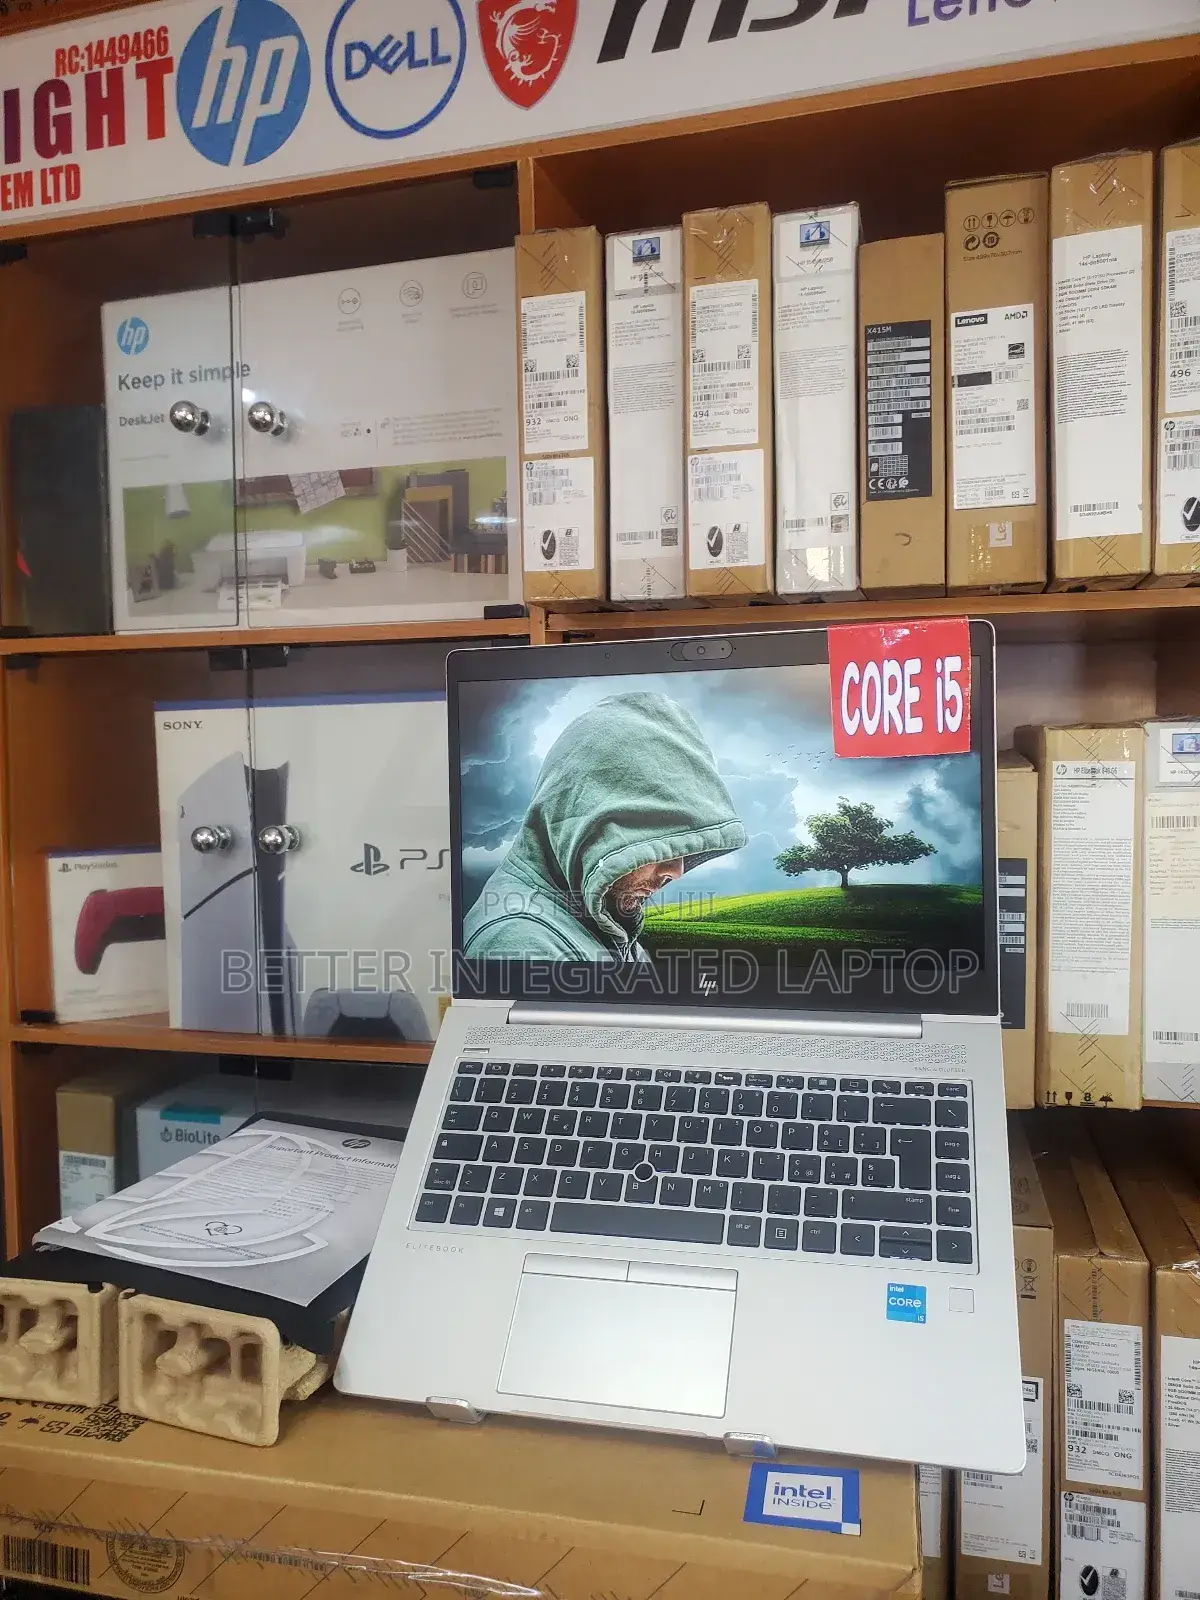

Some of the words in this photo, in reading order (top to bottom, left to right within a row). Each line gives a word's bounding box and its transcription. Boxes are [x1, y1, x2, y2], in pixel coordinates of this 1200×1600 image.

[55, 25, 169, 78] RC:1449466
[345, 27, 452, 81] DELL
[40, 163, 81, 206] LTD
[956, 315, 985, 325] Lenovo
[1004, 311, 1022, 321] AMD
[121, 316, 147, 355] hp
[867, 325, 892, 334] X415M
[118, 373, 165, 391] Keep
[171, 368, 183, 384] it
[189, 361, 251, 383] simple
[1170, 368, 1191, 378] 496
[119, 413, 165, 427] DeskJet
[525, 418, 542, 426] 932
[563, 414, 579, 422] ONG
[692, 409, 710, 419] 494
[841, 657, 924, 737] CORE
[935, 655, 965, 735] i5
[163, 719, 203, 731] SONY
[491, 1111, 498, 1119] Q
[522, 1112, 533, 1120] W
[685, 1121, 692, 1129] U
[754, 1126, 762, 1134] O
[175, 1129, 220, 1145] BioLite
[267, 1144, 314, 1156] Important
[314, 1150, 351, 1162] Product
[491, 1140, 498, 1148] A
[523, 1142, 529, 1150] S
[622, 1148, 629, 1156] G
[655, 1150, 661, 1158] H
[724, 1155, 731, 1163] K
[760, 1157, 764, 1165] L
[499, 1172, 506, 1180] Z
[532, 1174, 539, 1182] X
[565, 1176, 572, 1184] C
[600, 1178, 606, 1186] V
[667, 1183, 675, 1191] N
[405, 1242, 465, 1253] ELITEBOOK
[889, 1285, 904, 1293] intel
[1067, 1444, 1087, 1454] 932
[1113, 1451, 1133, 1459] ONG
[773, 1482, 832, 1500] intel
